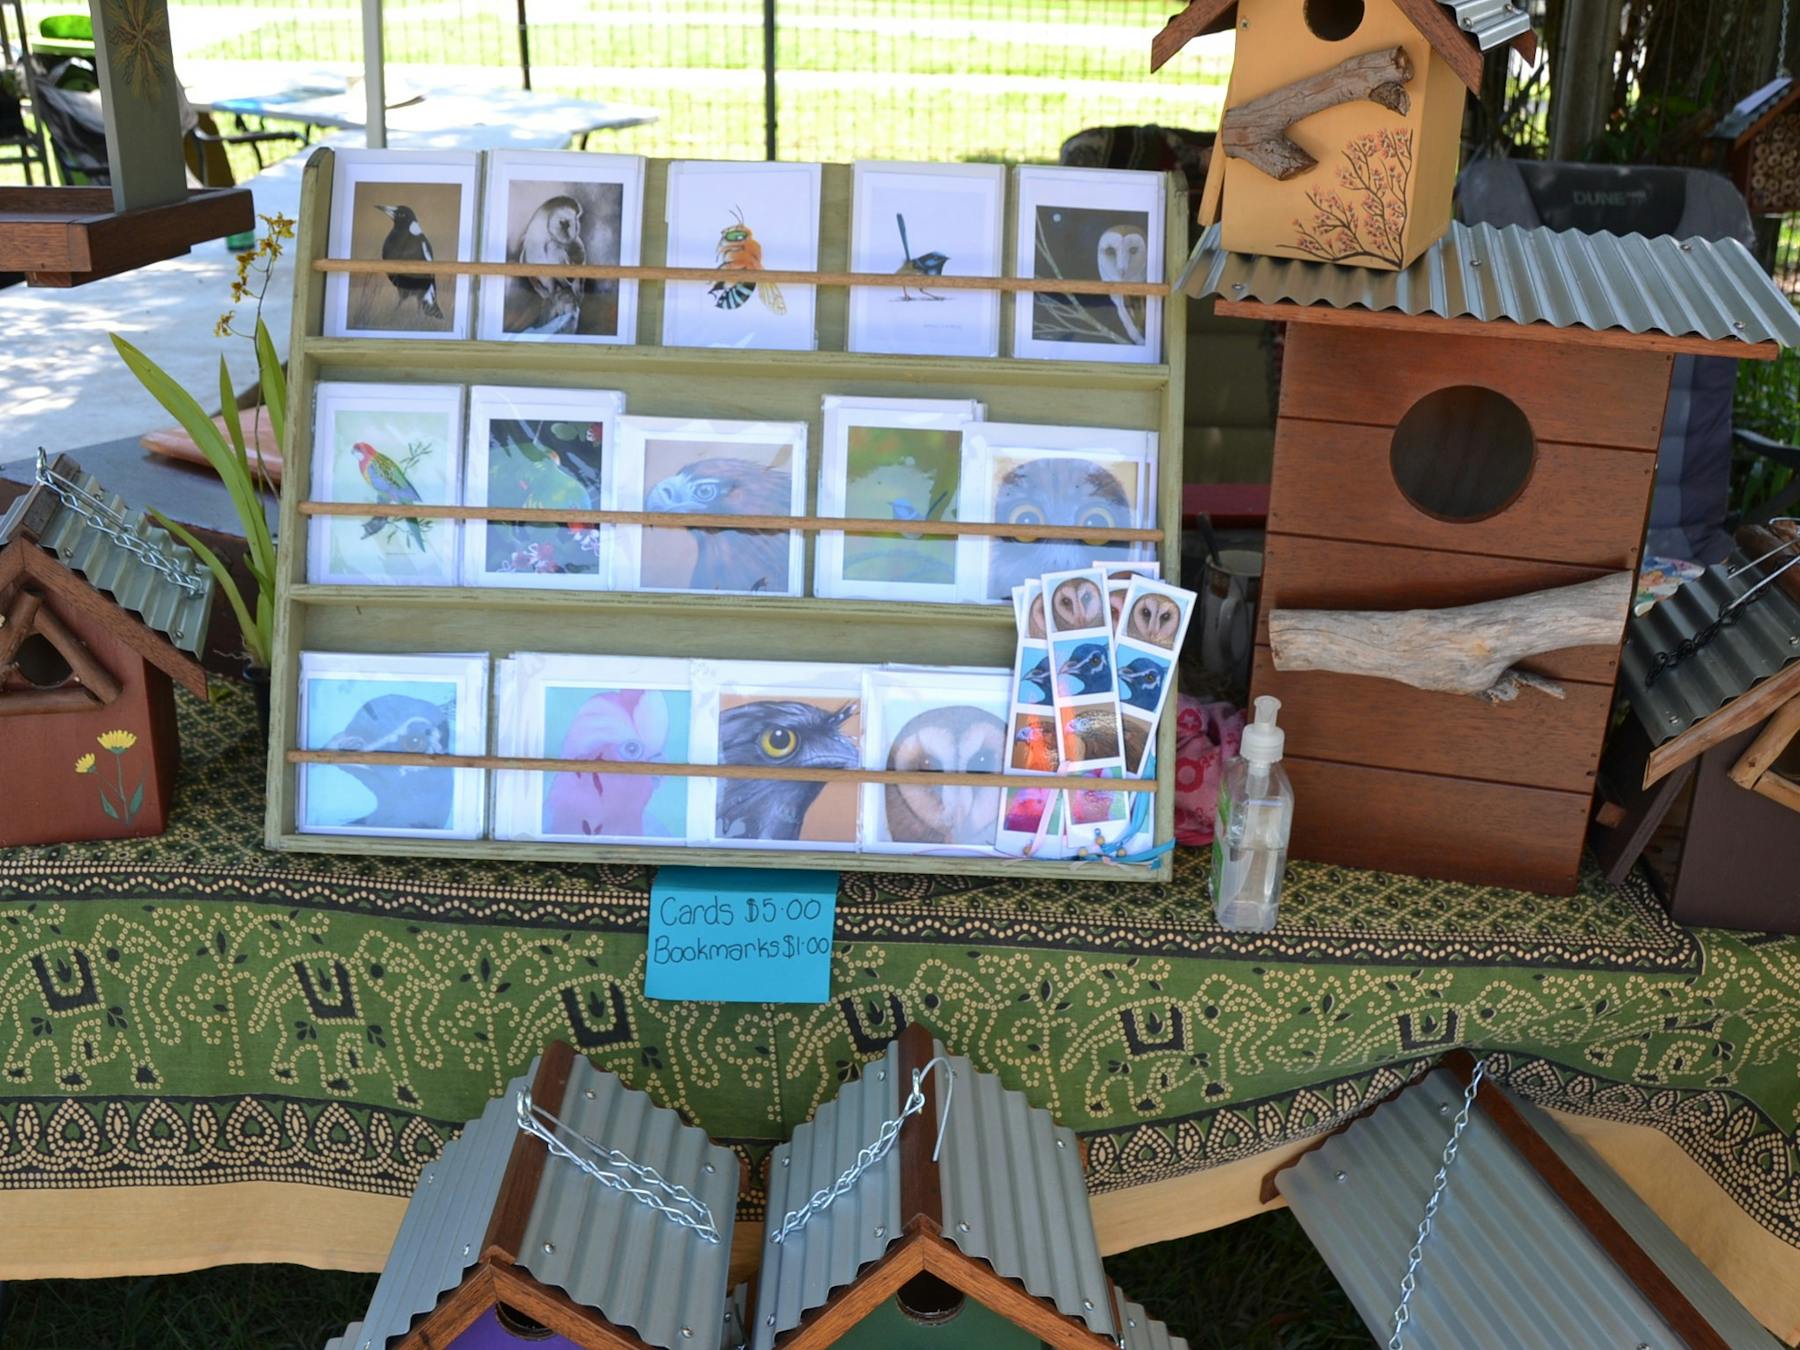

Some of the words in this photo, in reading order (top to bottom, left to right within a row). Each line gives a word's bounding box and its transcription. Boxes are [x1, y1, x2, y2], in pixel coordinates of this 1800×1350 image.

[1573, 190, 1626, 206] DUNE
[660, 895, 735, 927] Cards
[744, 897, 822, 923] $5.00
[653, 934, 780, 965] Bookmarks
